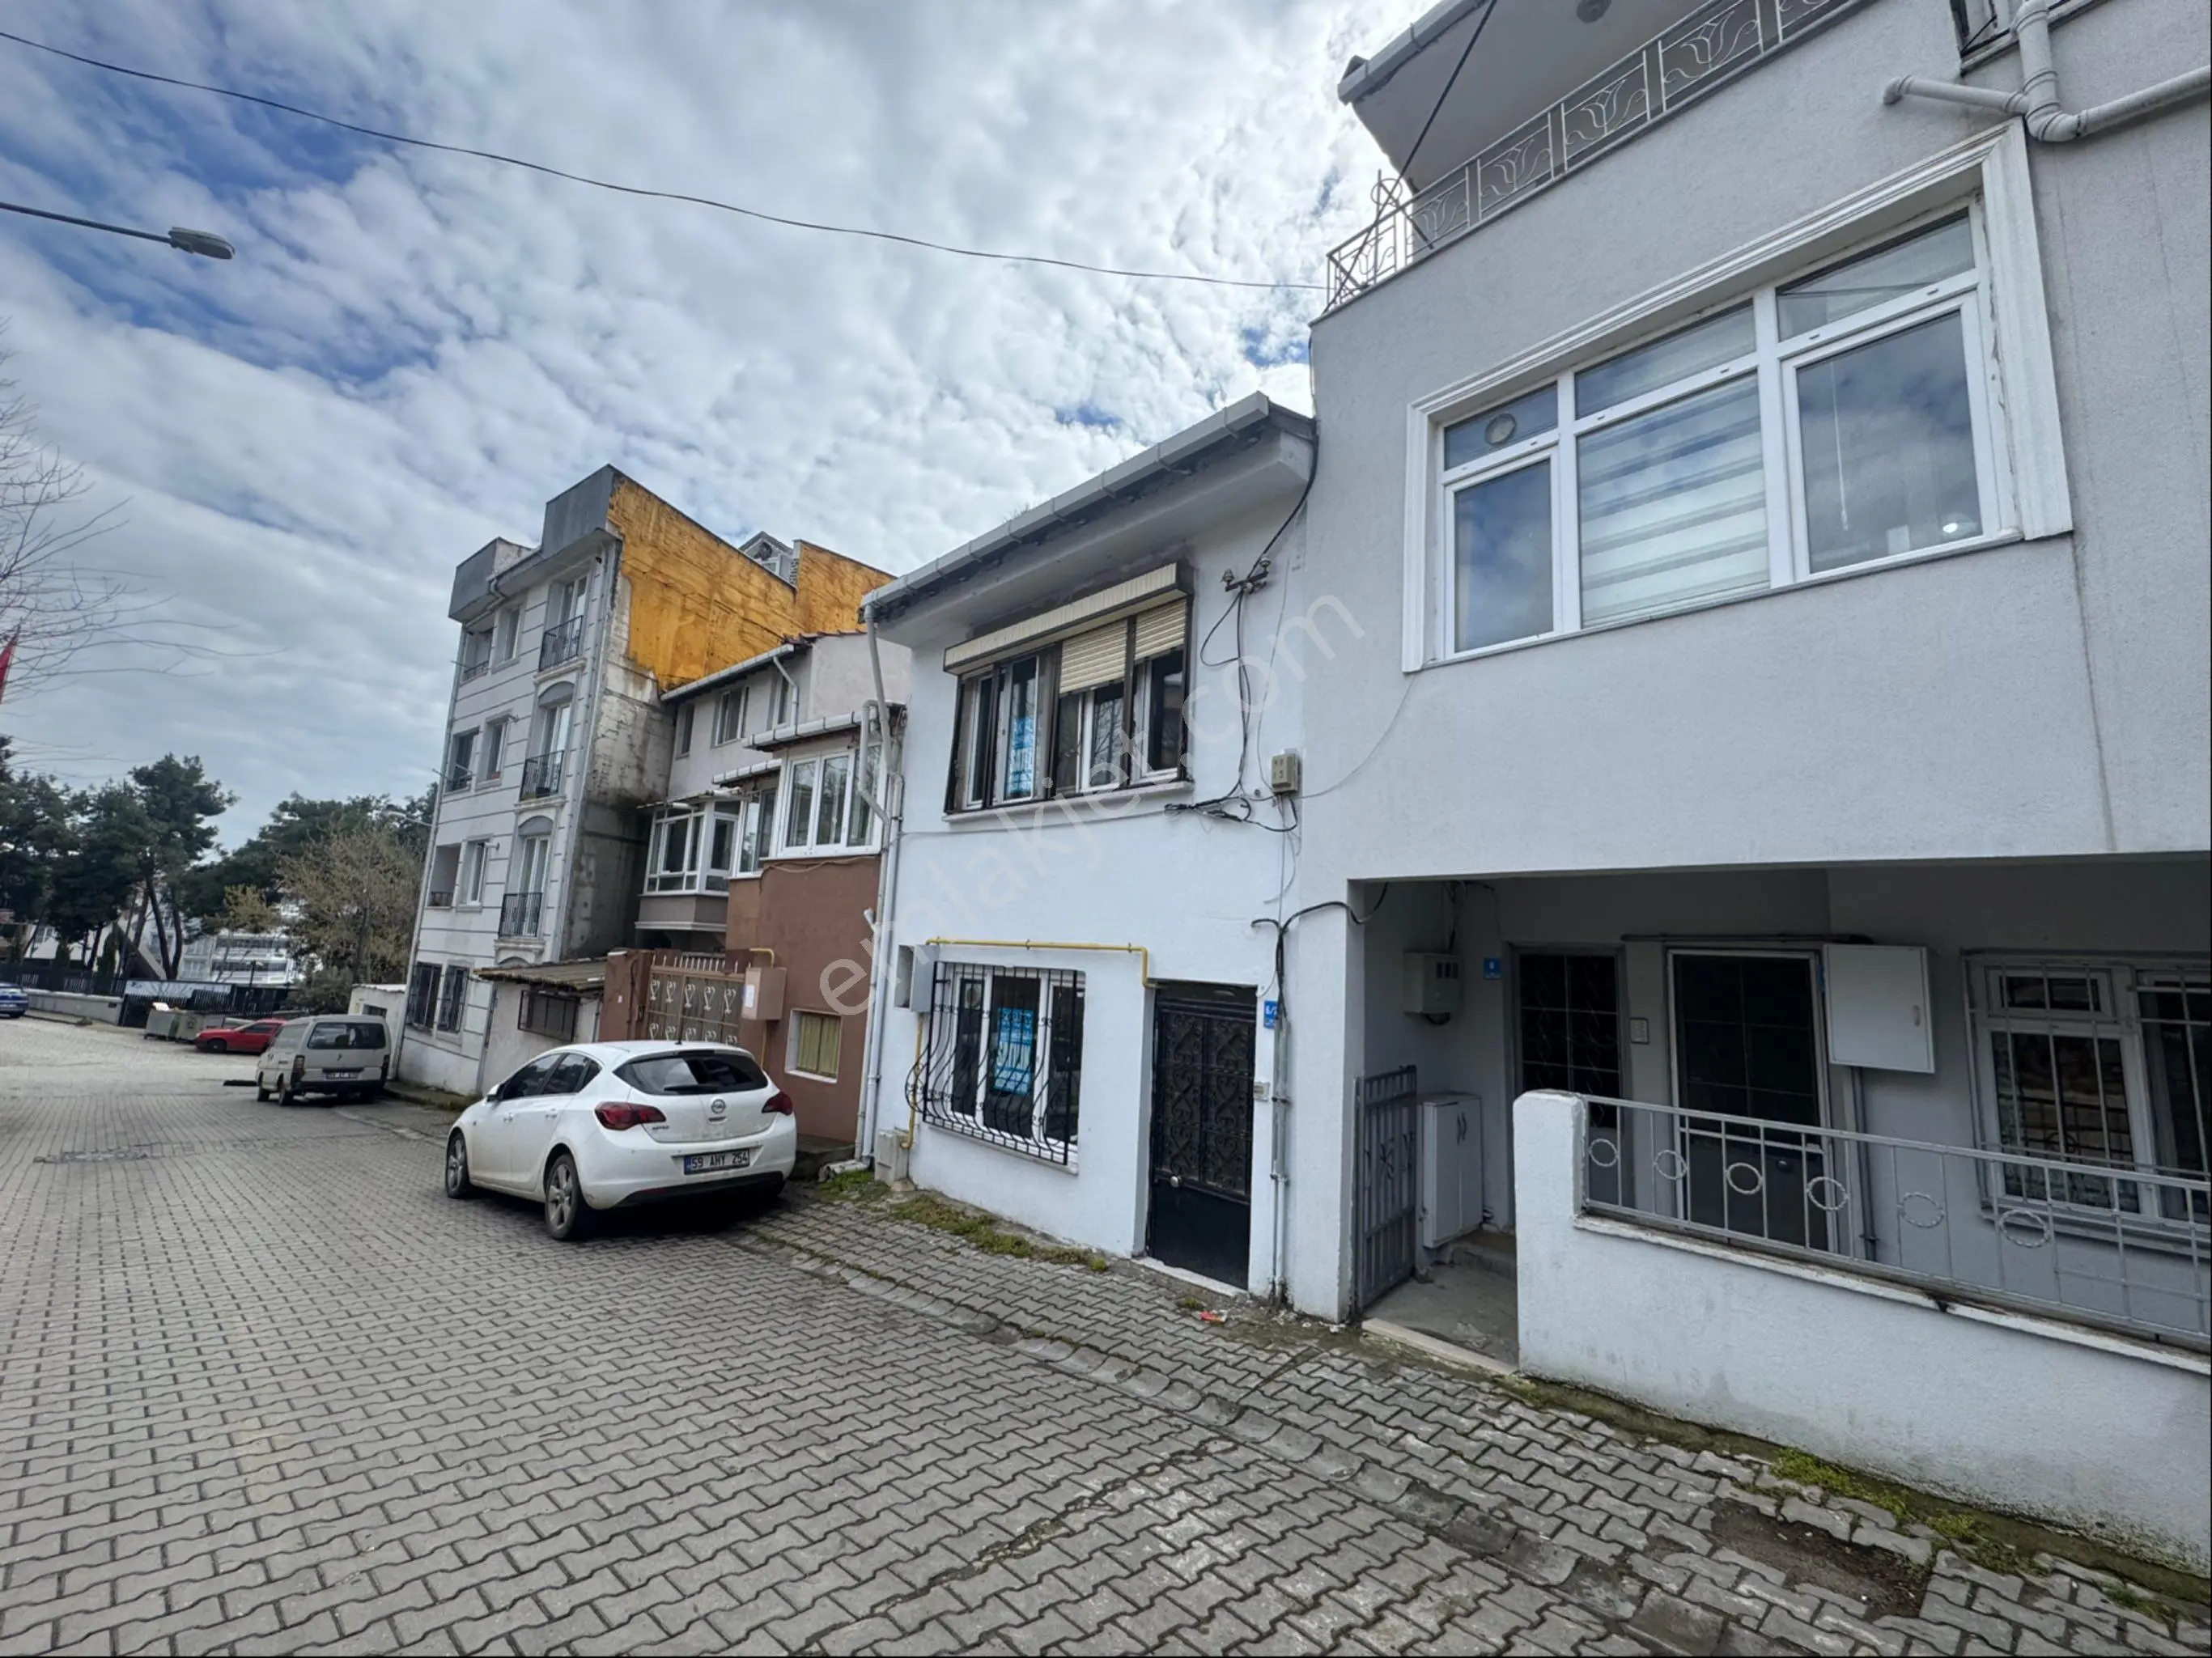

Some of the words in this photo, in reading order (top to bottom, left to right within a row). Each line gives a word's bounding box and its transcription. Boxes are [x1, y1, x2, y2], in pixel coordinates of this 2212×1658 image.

[692, 1156, 703, 1168] 59
[710, 1153, 725, 1166] AHY
[732, 1151, 748, 1164] 254
